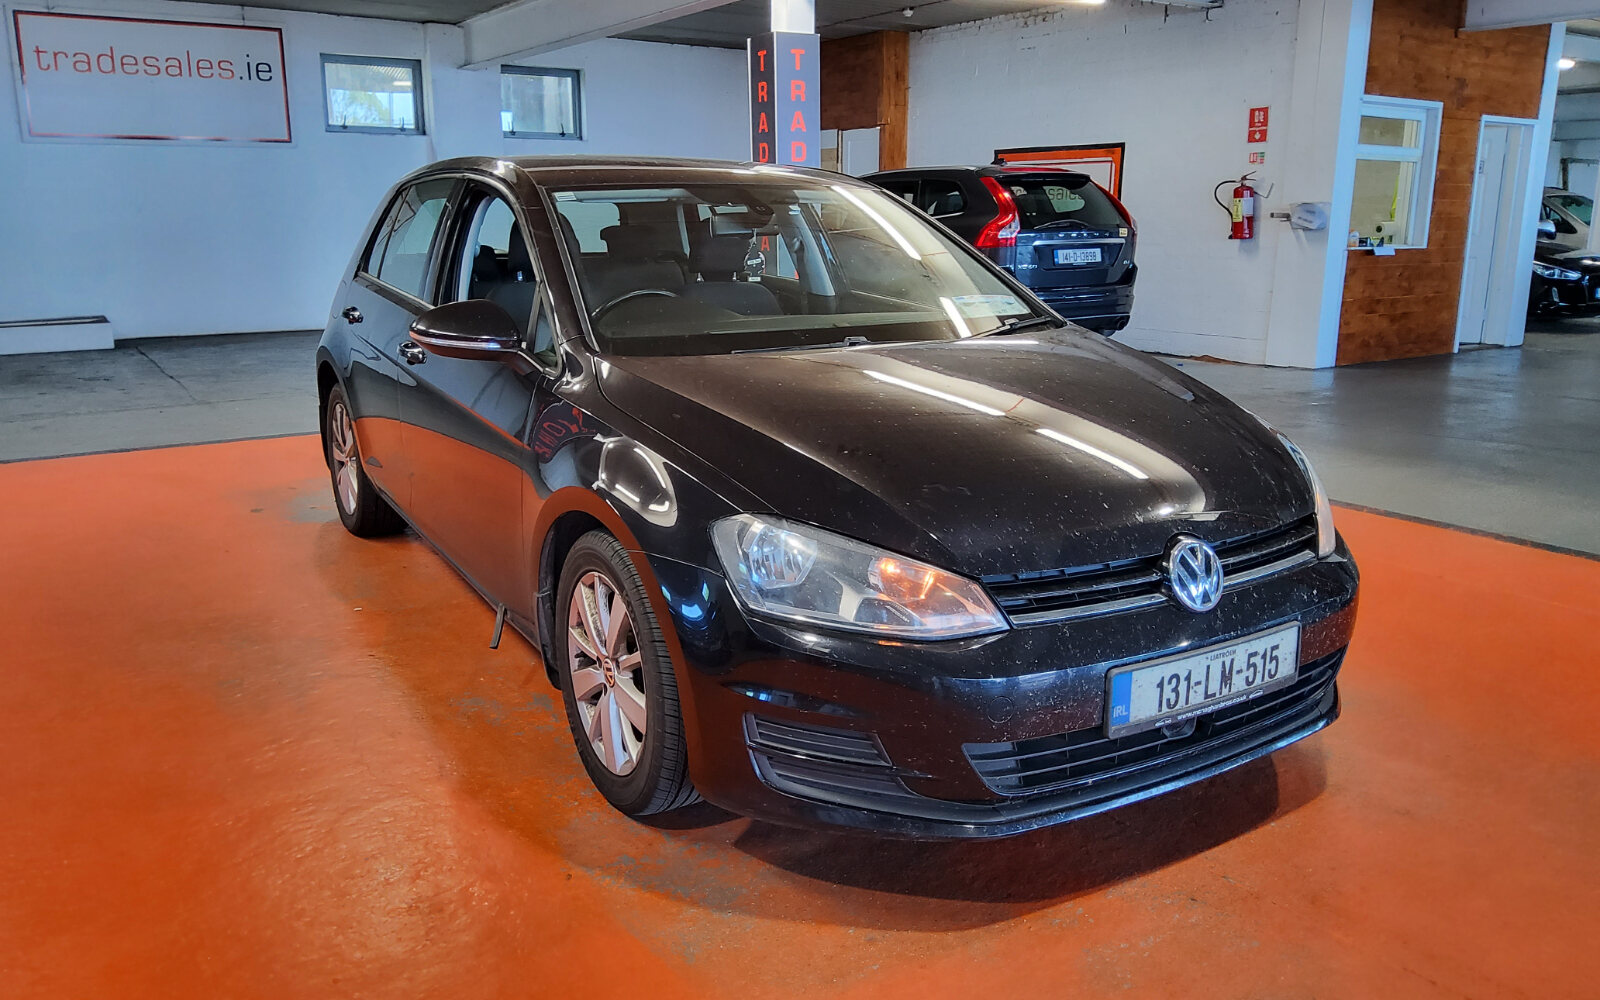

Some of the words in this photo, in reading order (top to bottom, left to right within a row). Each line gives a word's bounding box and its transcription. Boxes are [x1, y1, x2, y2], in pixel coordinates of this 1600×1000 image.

[33, 45, 273, 82] tradesales.ie
[1156, 644, 1280, 713] 131-LM-515
[1112, 706, 1129, 718] IRL
